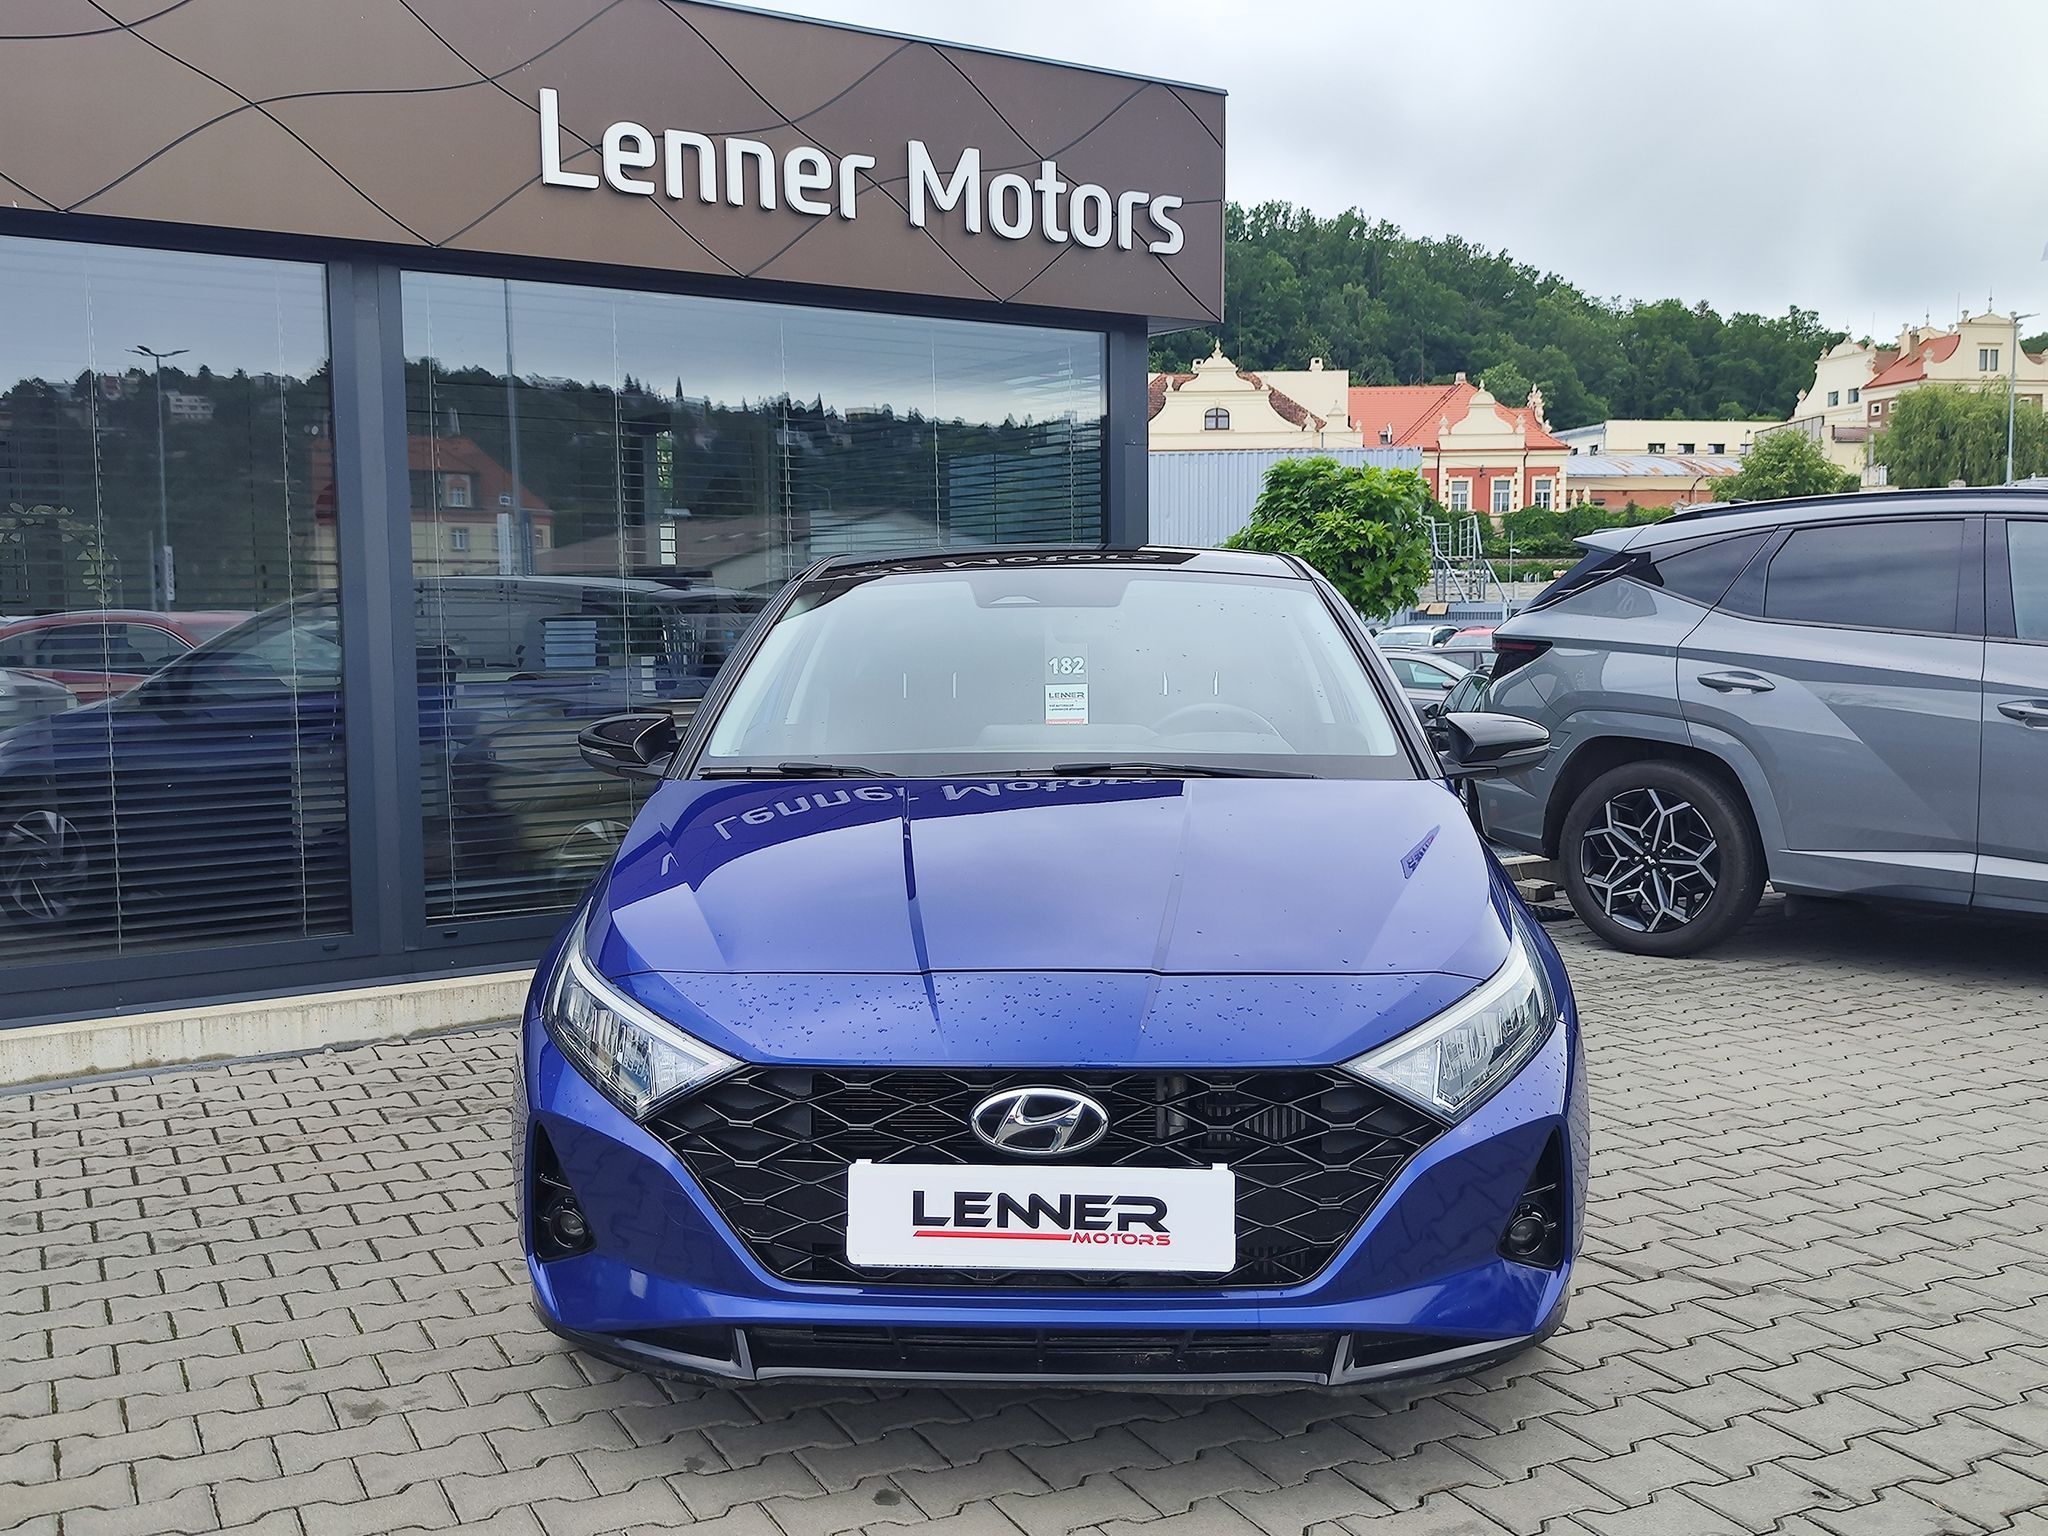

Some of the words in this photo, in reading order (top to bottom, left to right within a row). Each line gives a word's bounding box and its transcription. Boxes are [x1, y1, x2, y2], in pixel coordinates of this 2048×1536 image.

[539, 87, 875, 221] Lenner
[906, 139, 1185, 255] Motors
[1048, 656, 1086, 675] 182
[1048, 691, 1086, 699] LENNER
[912, 1190, 1169, 1233] LENNER
[1072, 1231, 1172, 1247] MOTORS
